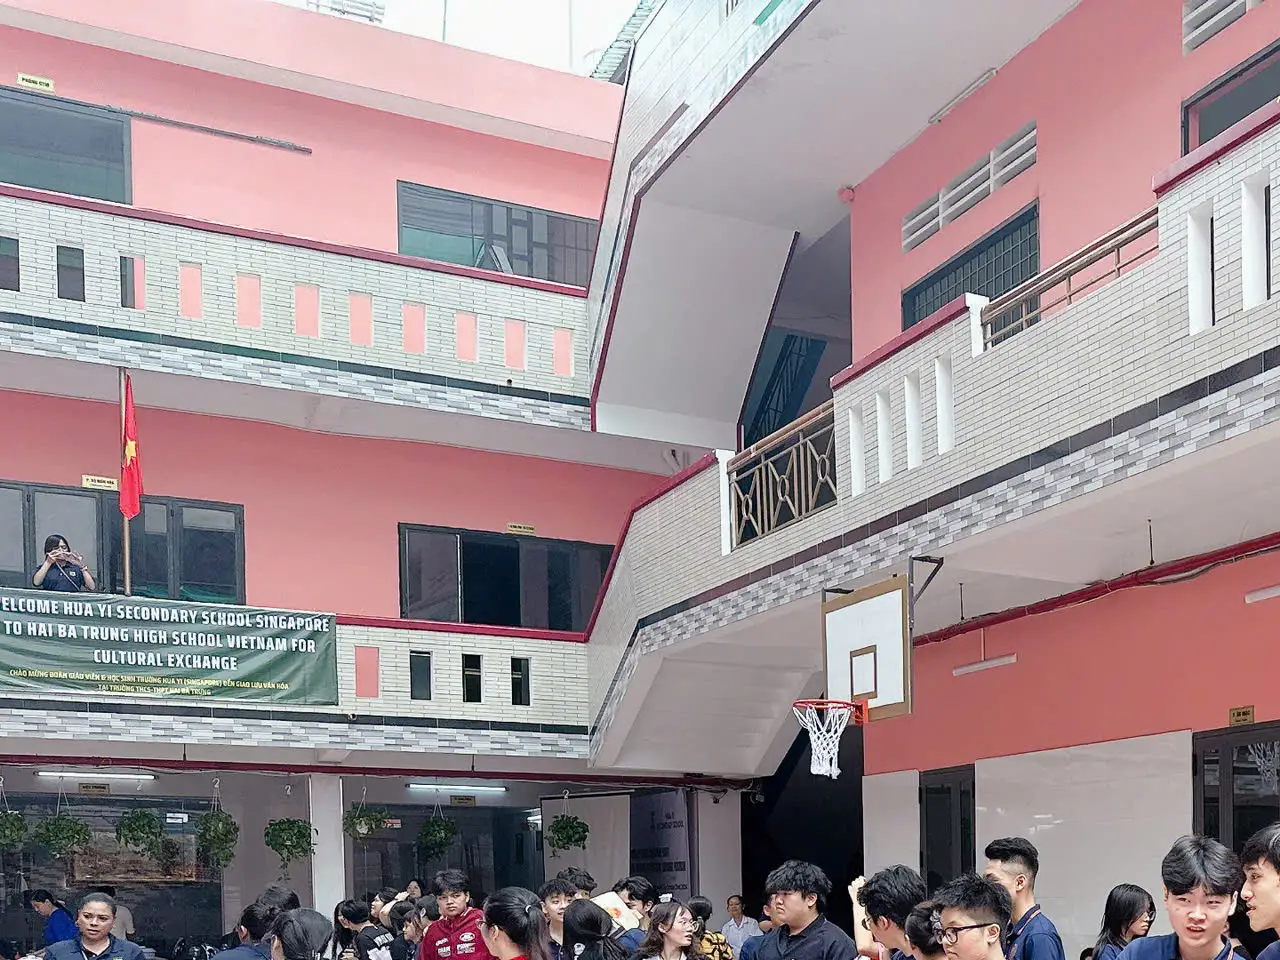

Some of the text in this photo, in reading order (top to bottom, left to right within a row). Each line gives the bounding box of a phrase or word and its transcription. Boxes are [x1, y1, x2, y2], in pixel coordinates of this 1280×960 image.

[0, 597, 330, 632] ELCOME HUA YI SECONDARY SCHOOL SINGAPORE
[4, 620, 316, 653] TO HAI BA TRUNG HIGH SCHOOL VIETNAM FOR
[94, 649, 237, 671] CULTURAL EXCHANGE
